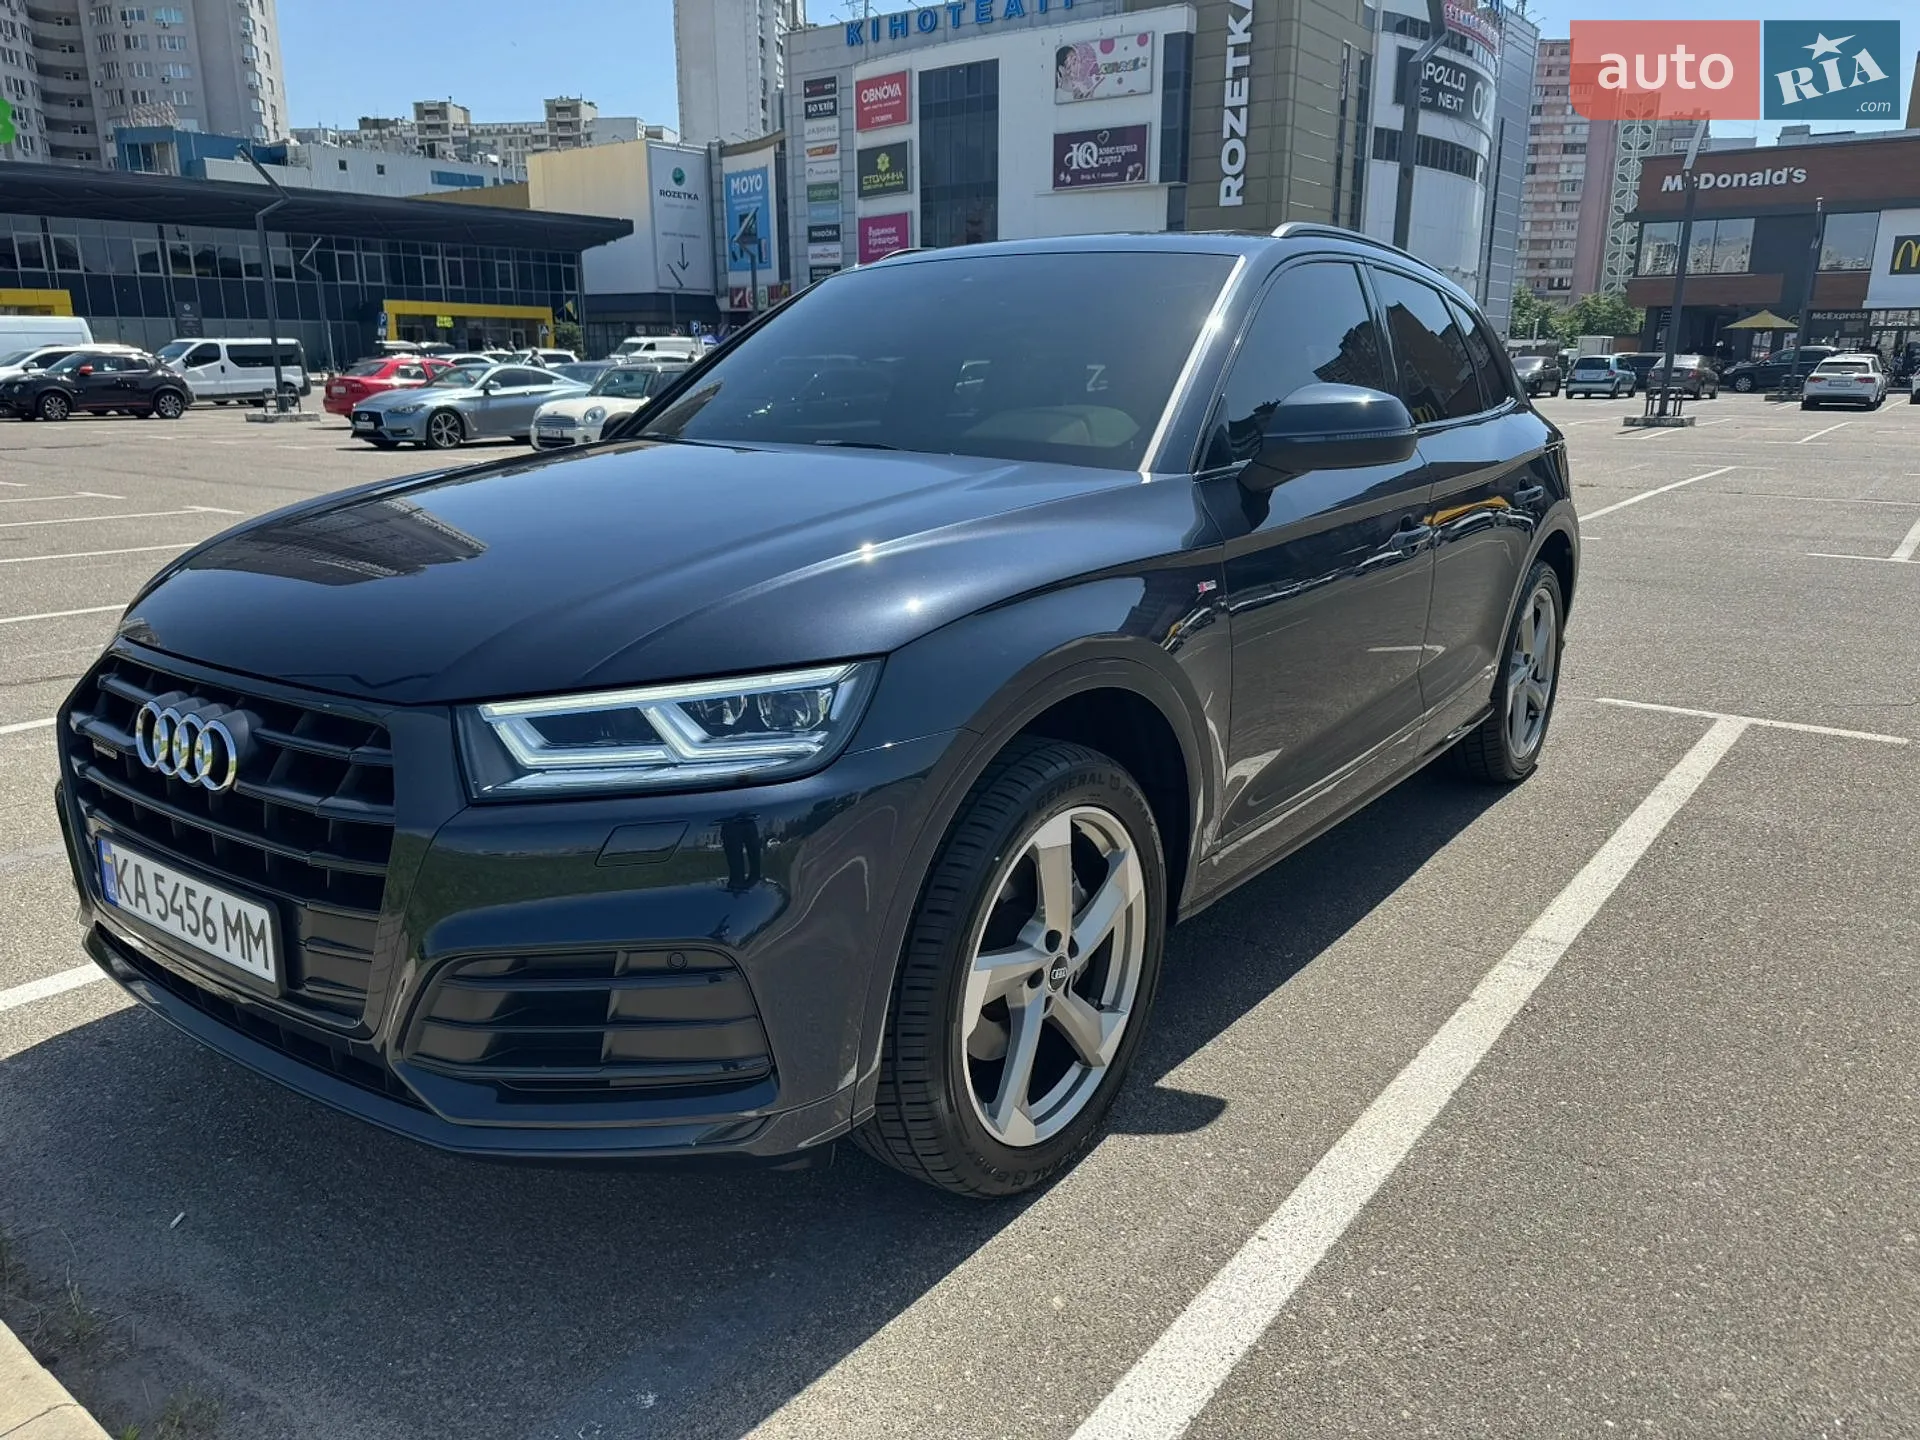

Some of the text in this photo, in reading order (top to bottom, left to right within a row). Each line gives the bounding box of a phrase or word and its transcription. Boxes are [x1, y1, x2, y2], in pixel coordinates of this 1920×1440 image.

[1437, 91, 1464, 112] NEXT
[659, 188, 699, 201] ROZETKA
[730, 174, 763, 197] MOYO
[1811, 311, 1868, 320] McExpress
[113, 853, 270, 970] KA 5456 MM
